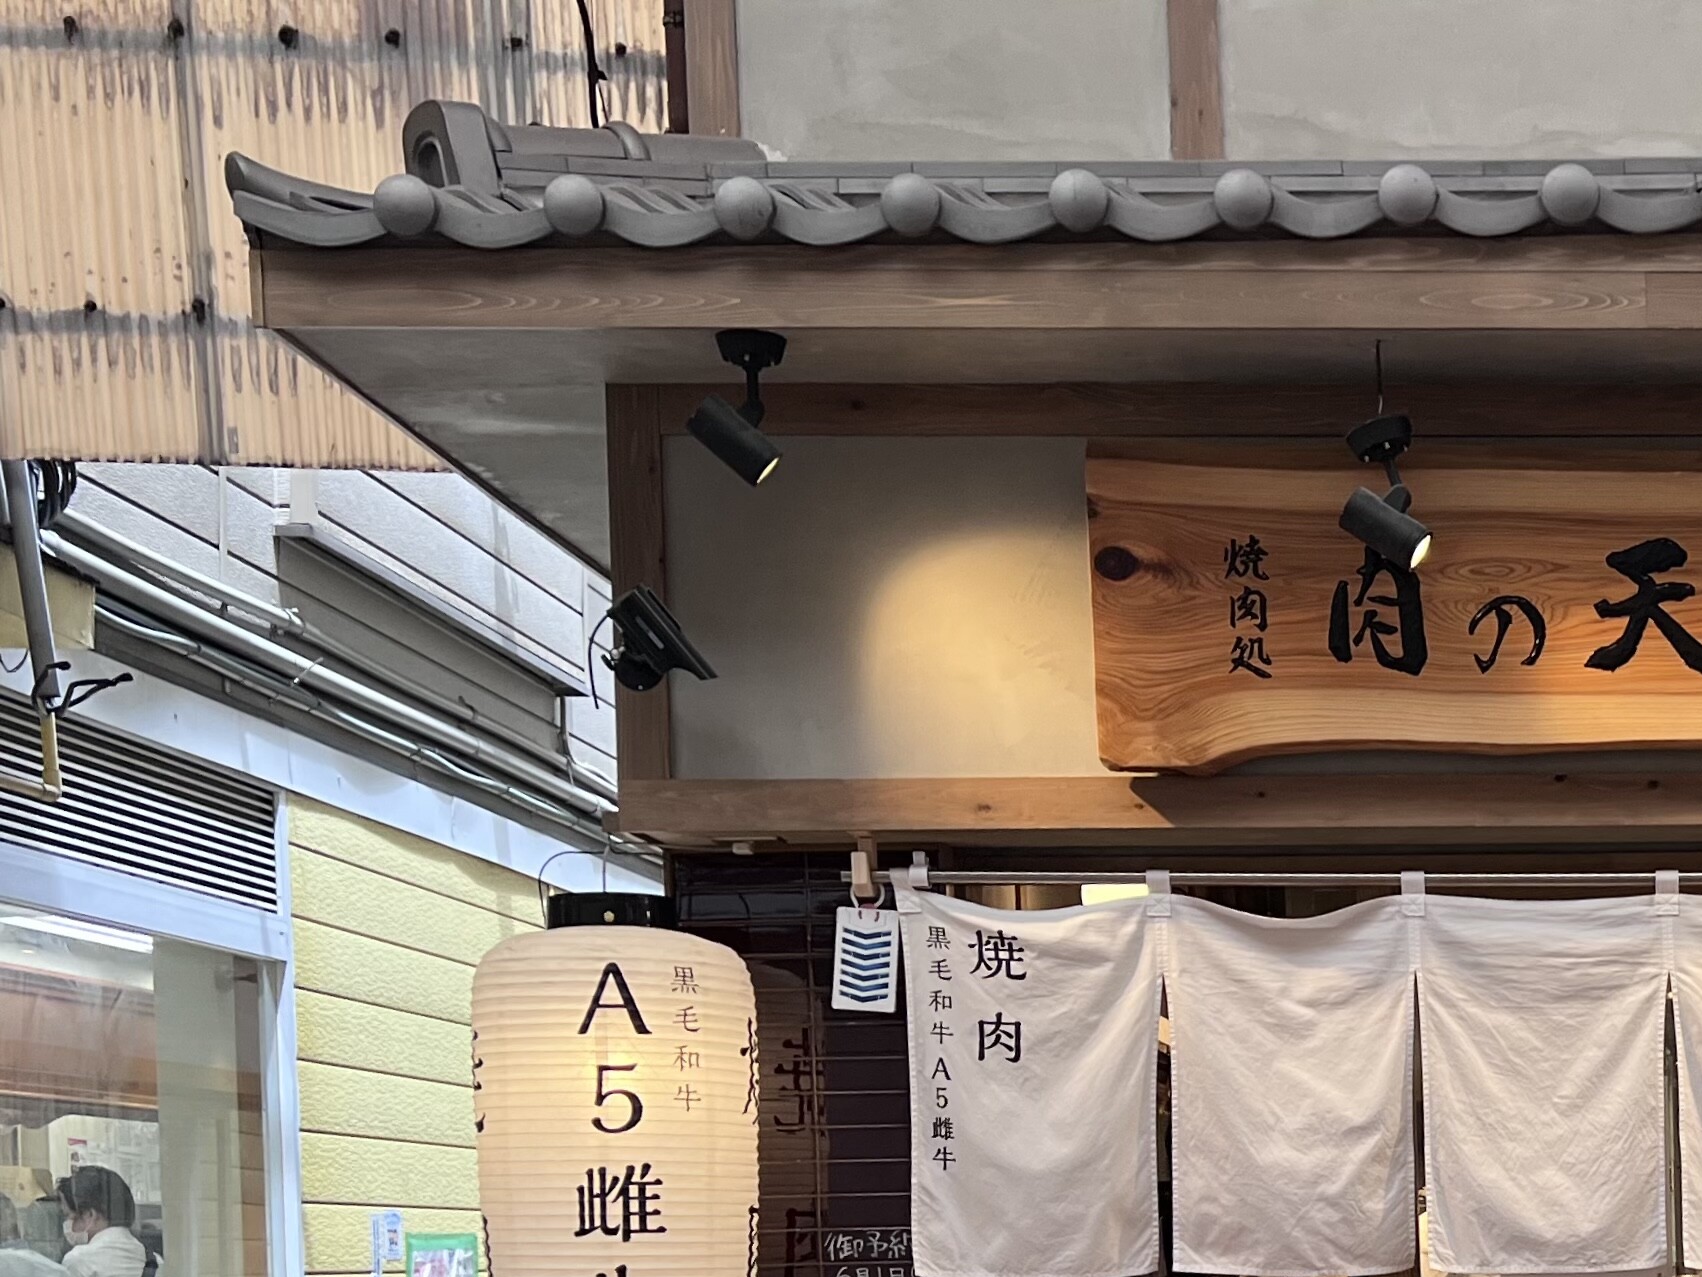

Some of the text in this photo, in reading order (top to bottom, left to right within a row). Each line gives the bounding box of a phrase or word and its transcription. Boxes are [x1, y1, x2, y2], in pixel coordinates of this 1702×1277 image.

[1223, 536, 1272, 680] 焼肉処
[670, 965, 702, 1113] 黒毛和牛
[926, 925, 957, 1172] 黒毛和牛A5雌牛
[967, 929, 1027, 1063] 焼肉
